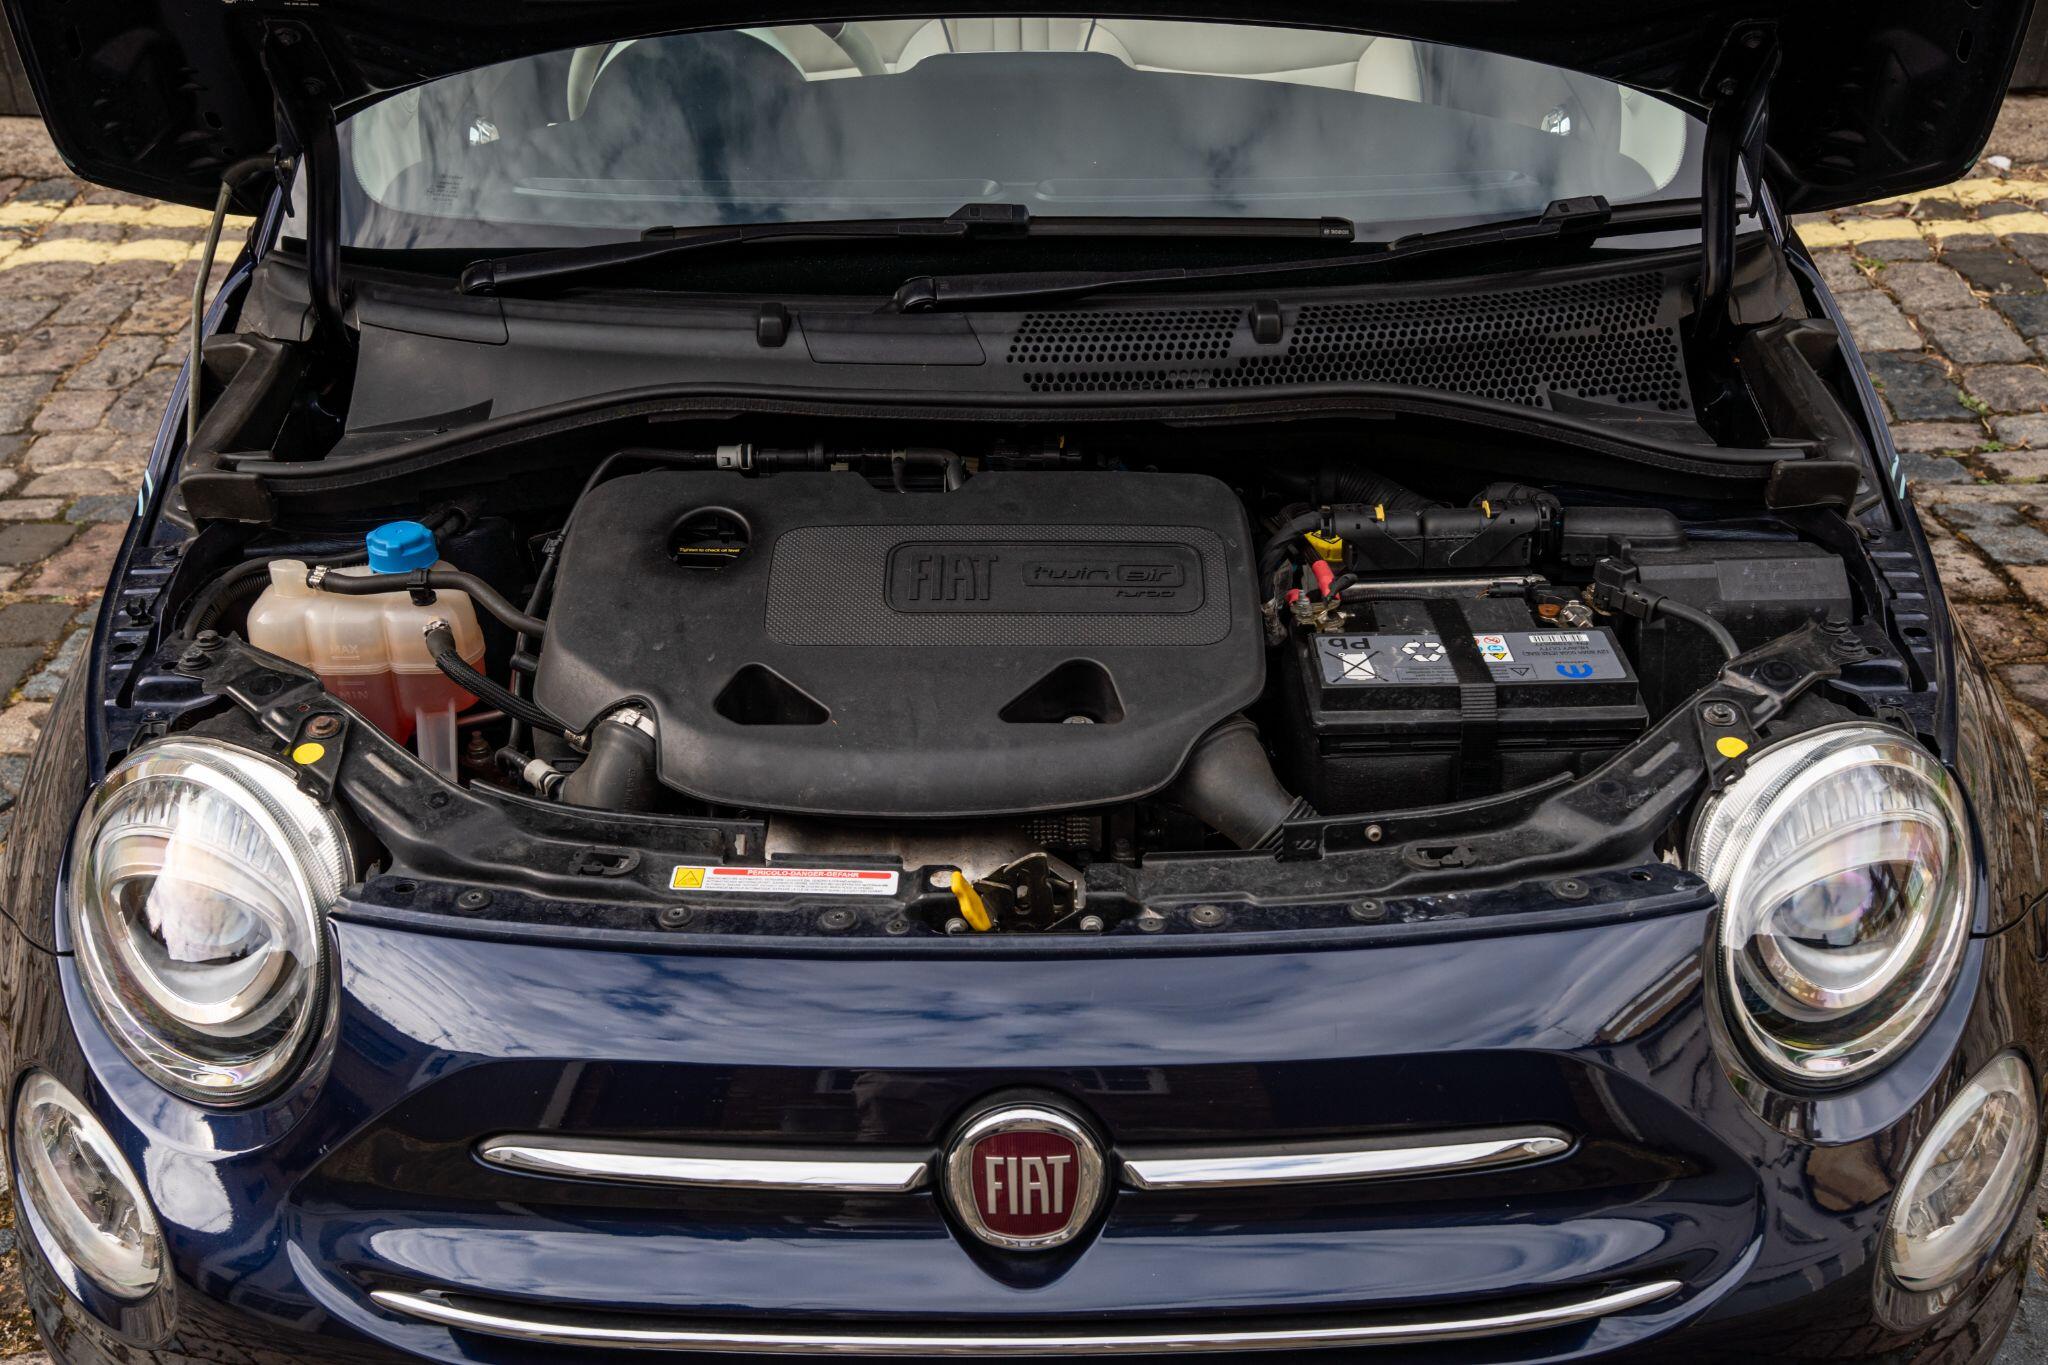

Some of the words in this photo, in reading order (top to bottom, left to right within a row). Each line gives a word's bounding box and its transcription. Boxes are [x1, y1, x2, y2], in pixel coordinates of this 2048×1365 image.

[909, 555, 999, 601] FIAT
[1034, 565, 1110, 581] twin
[1125, 566, 1174, 582] air
[1116, 589, 1176, 598] turbo
[330, 644, 359, 656] MAX
[1328, 637, 1371, 650] Pb
[985, 1155, 1071, 1215] FIAT
